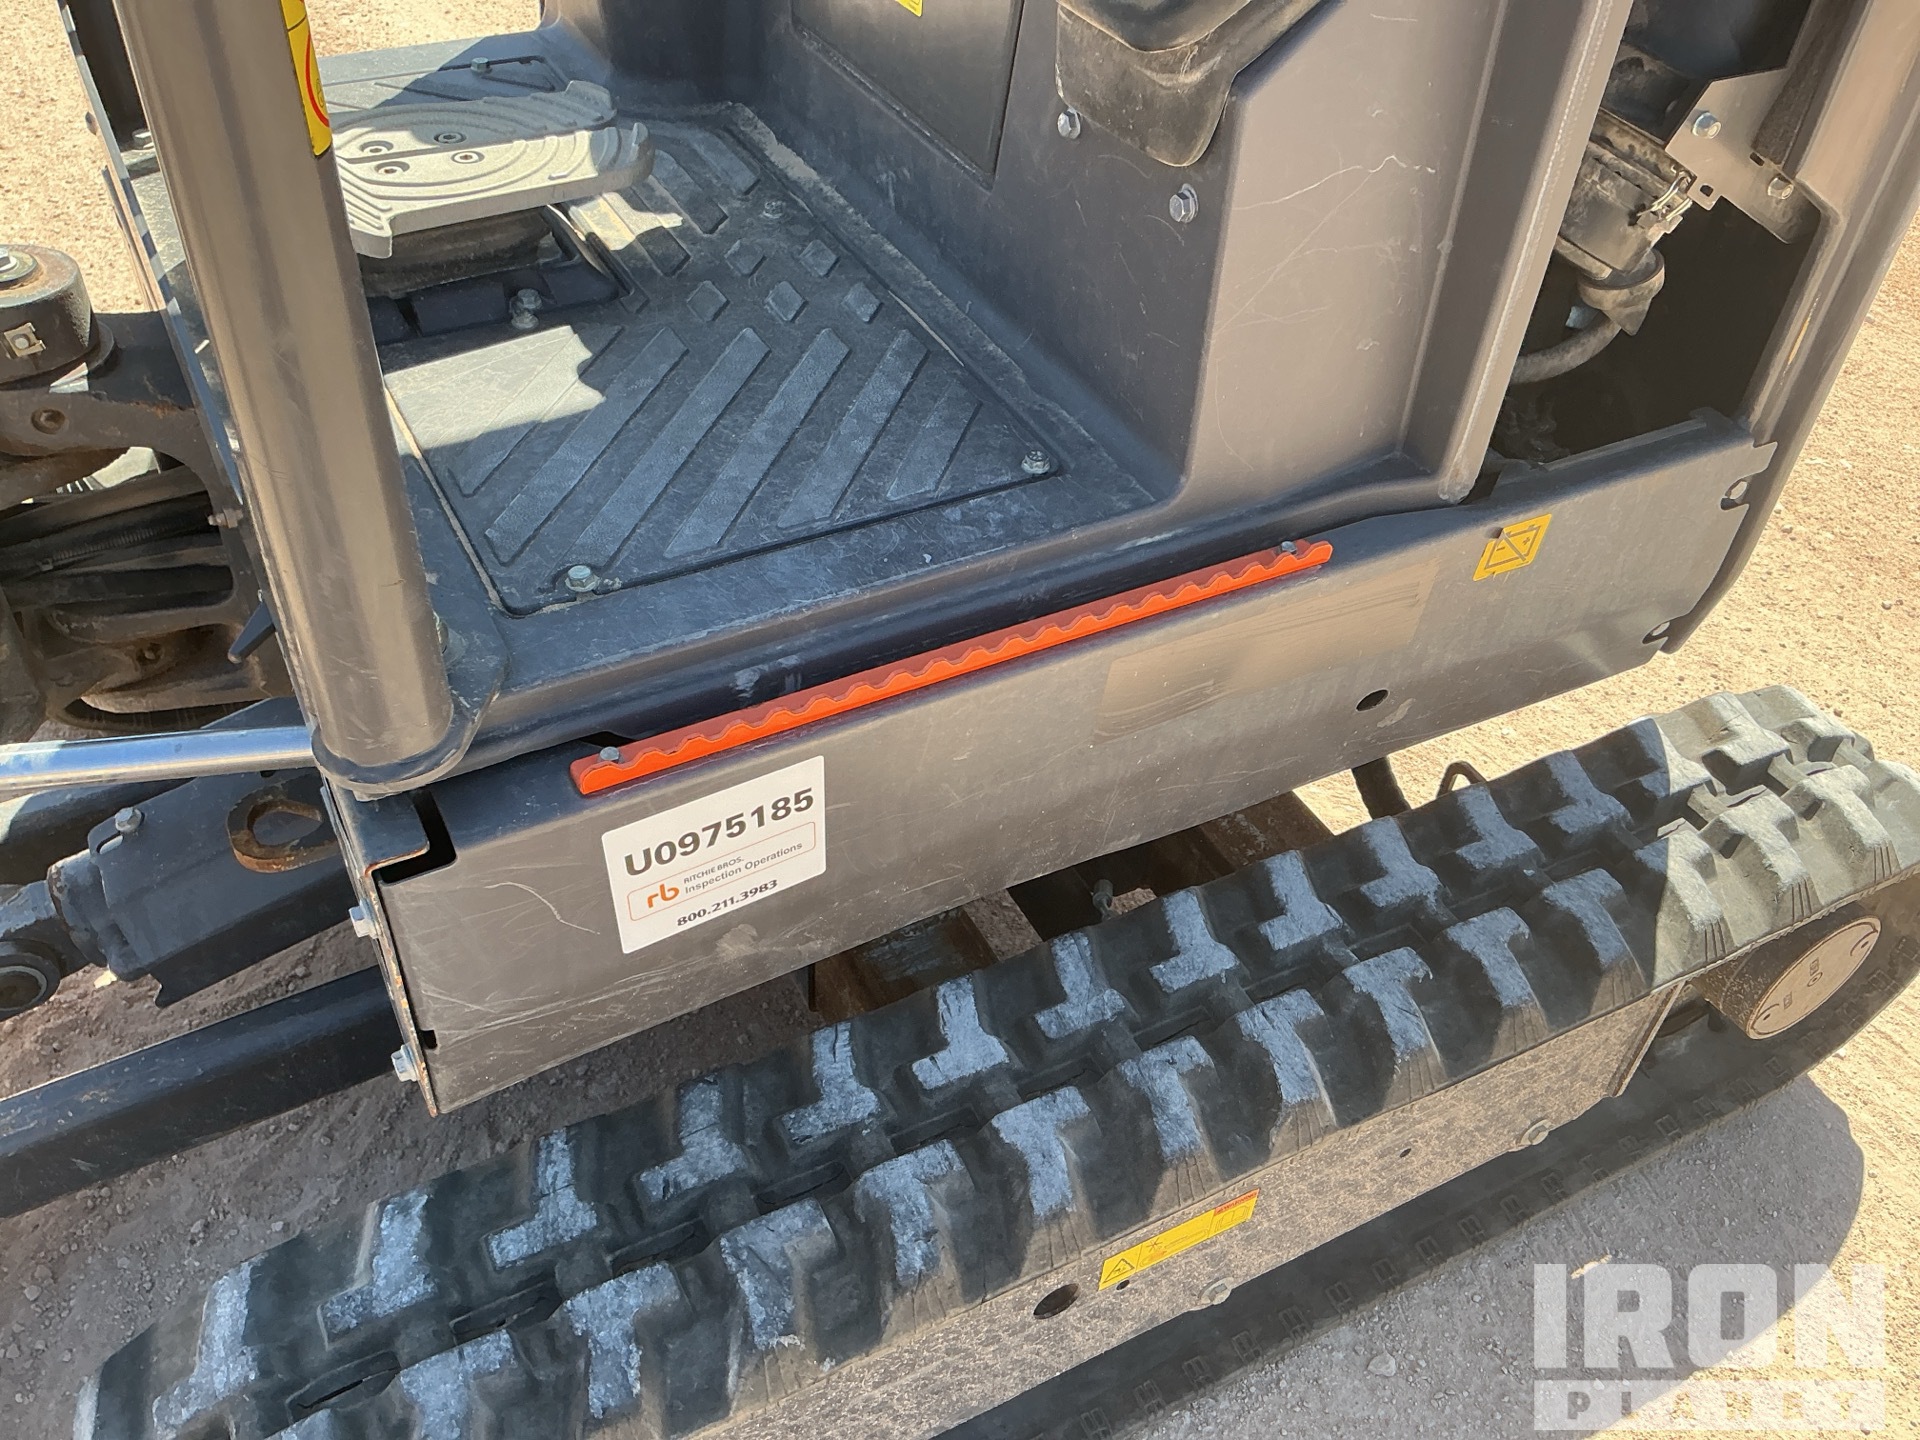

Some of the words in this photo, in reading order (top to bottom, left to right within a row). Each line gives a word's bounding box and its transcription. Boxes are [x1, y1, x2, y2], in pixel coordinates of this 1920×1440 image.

[624, 787, 814, 876] U0975185
[683, 866, 716, 884] RITCHIE
[717, 856, 745, 871] BROS.
[685, 867, 742, 894] Inspection
[744, 842, 803, 870] Operations
[647, 883, 680, 909] rb
[677, 879, 778, 926] 800.211.3983
